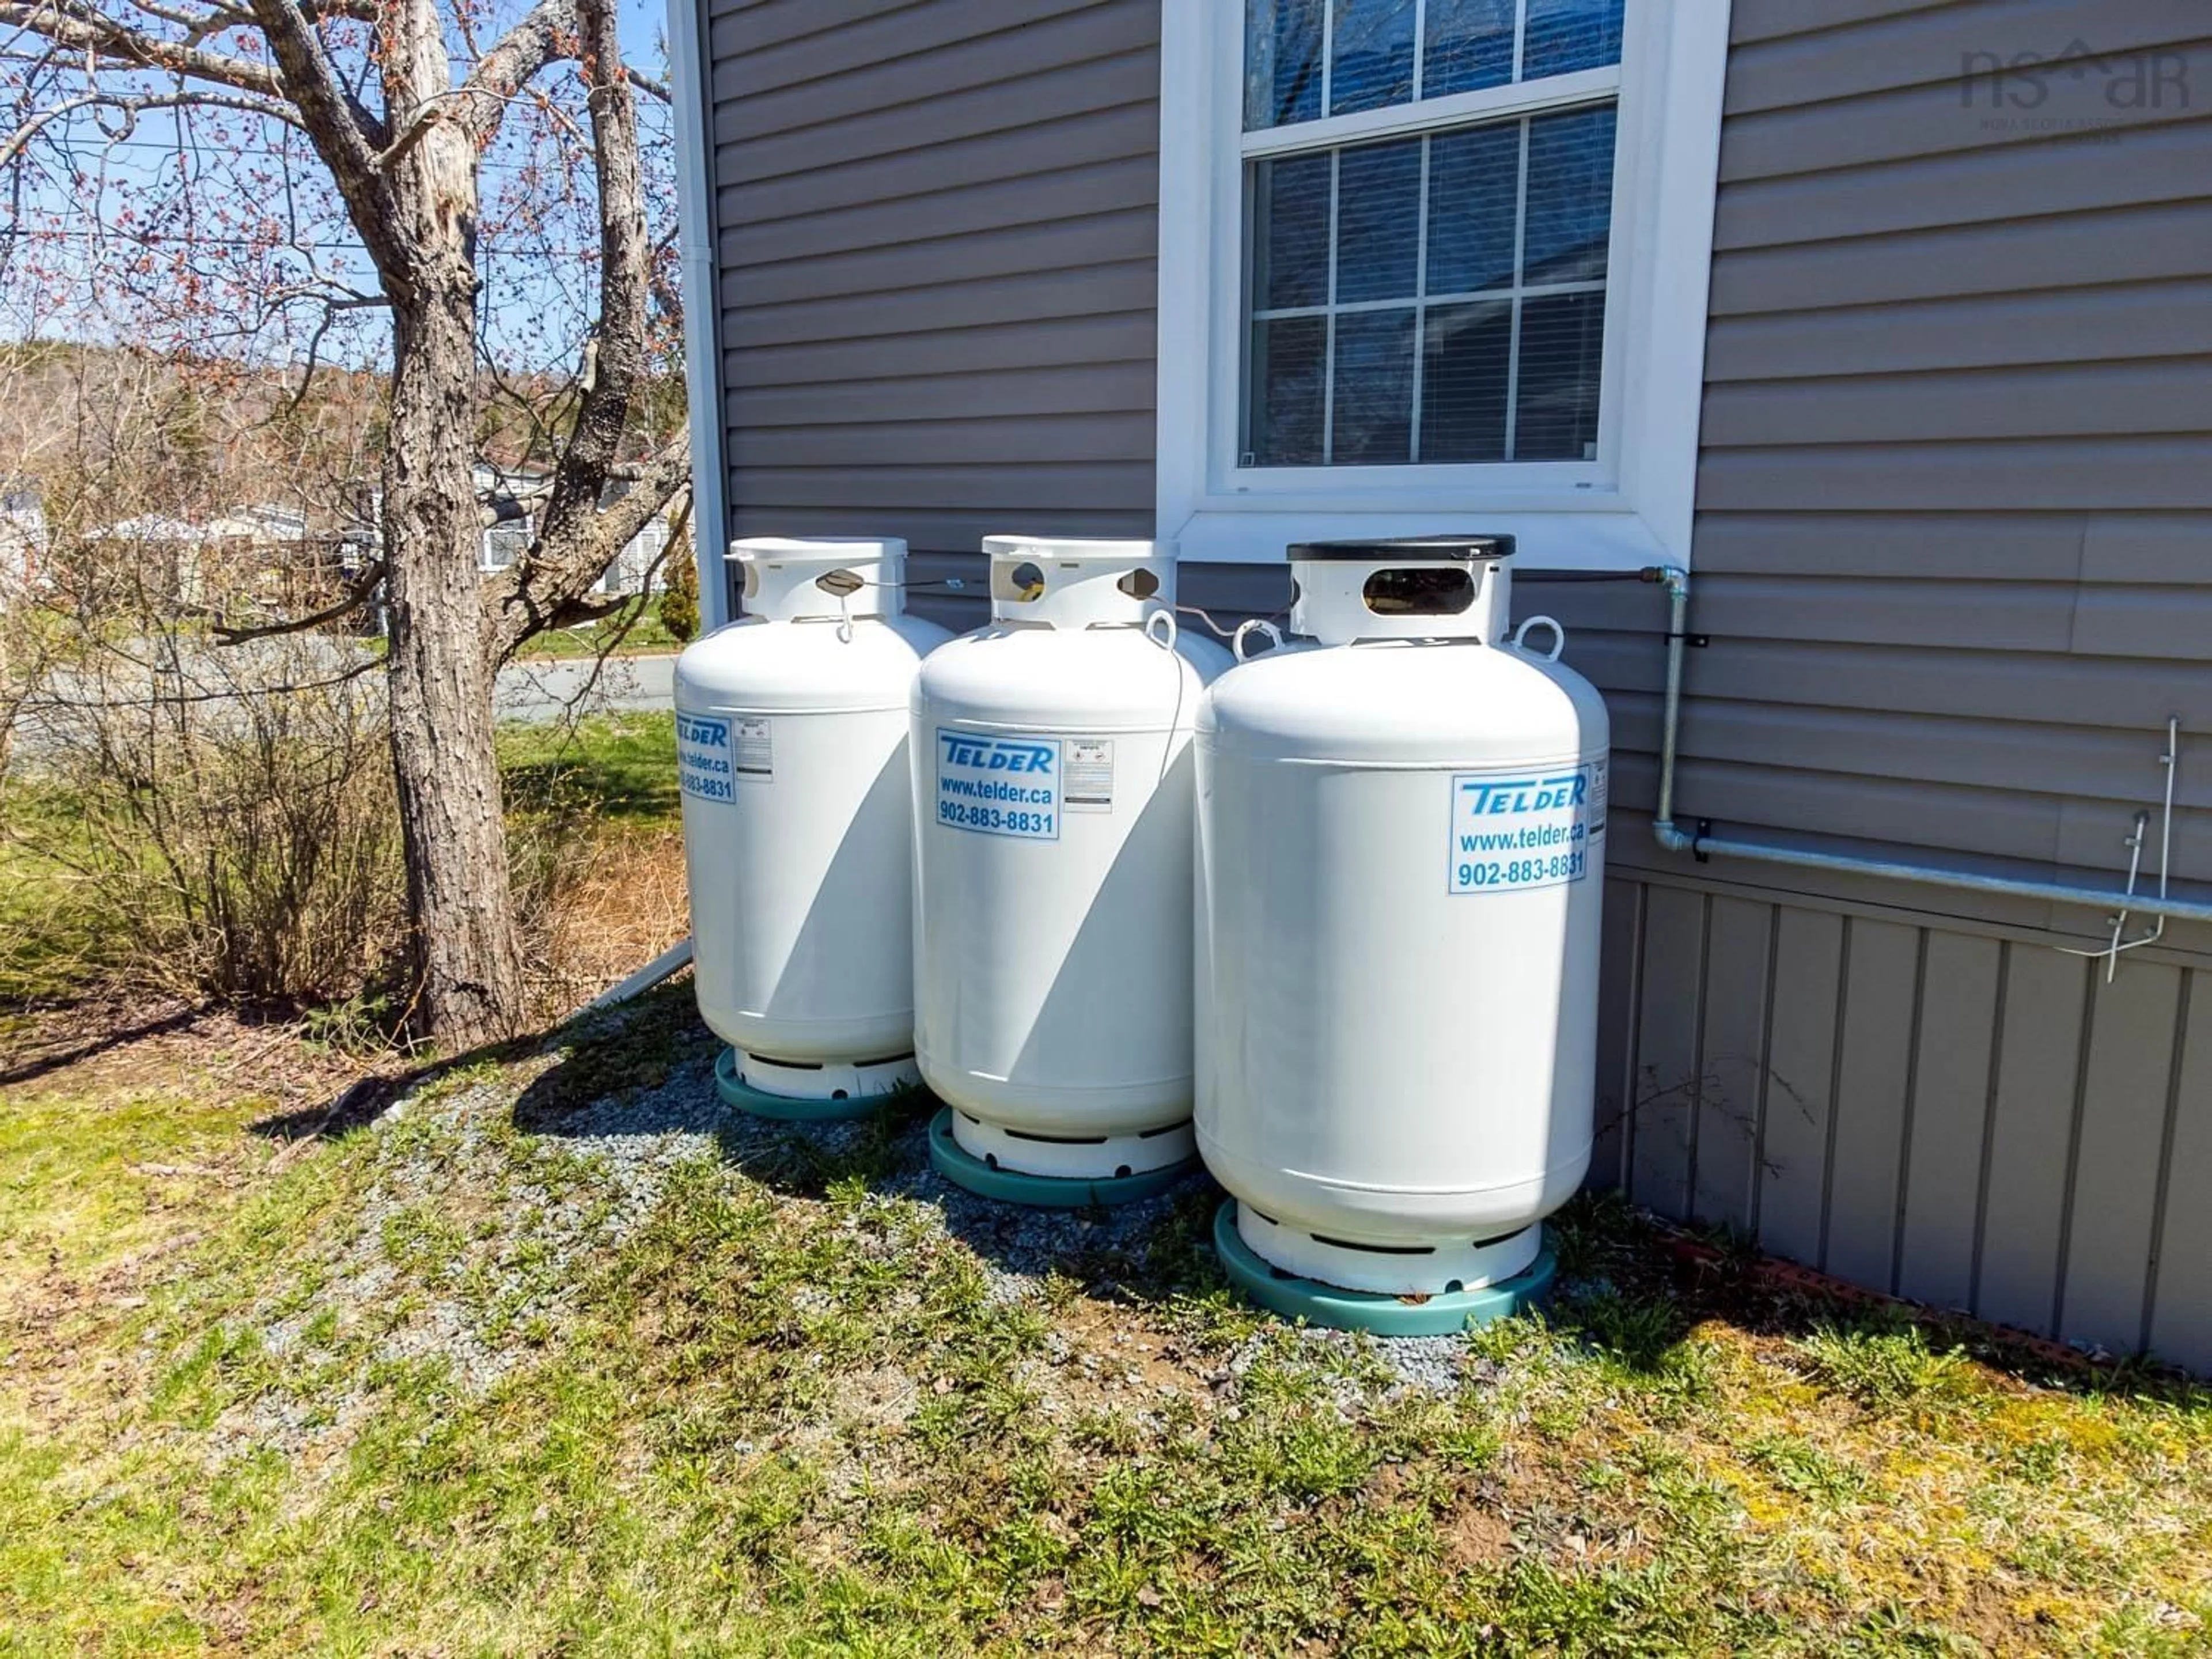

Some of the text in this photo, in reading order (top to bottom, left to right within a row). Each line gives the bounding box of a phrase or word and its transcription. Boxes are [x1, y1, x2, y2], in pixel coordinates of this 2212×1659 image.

[941, 735, 1054, 774] TELDER
[941, 777, 1052, 805] www.telder.ca
[1462, 774, 1586, 816] TELDER
[940, 800, 1052, 833] 902-883-8831
[1460, 823, 1585, 853] www.telder.ca
[1459, 850, 1584, 887] 902-883-8831
